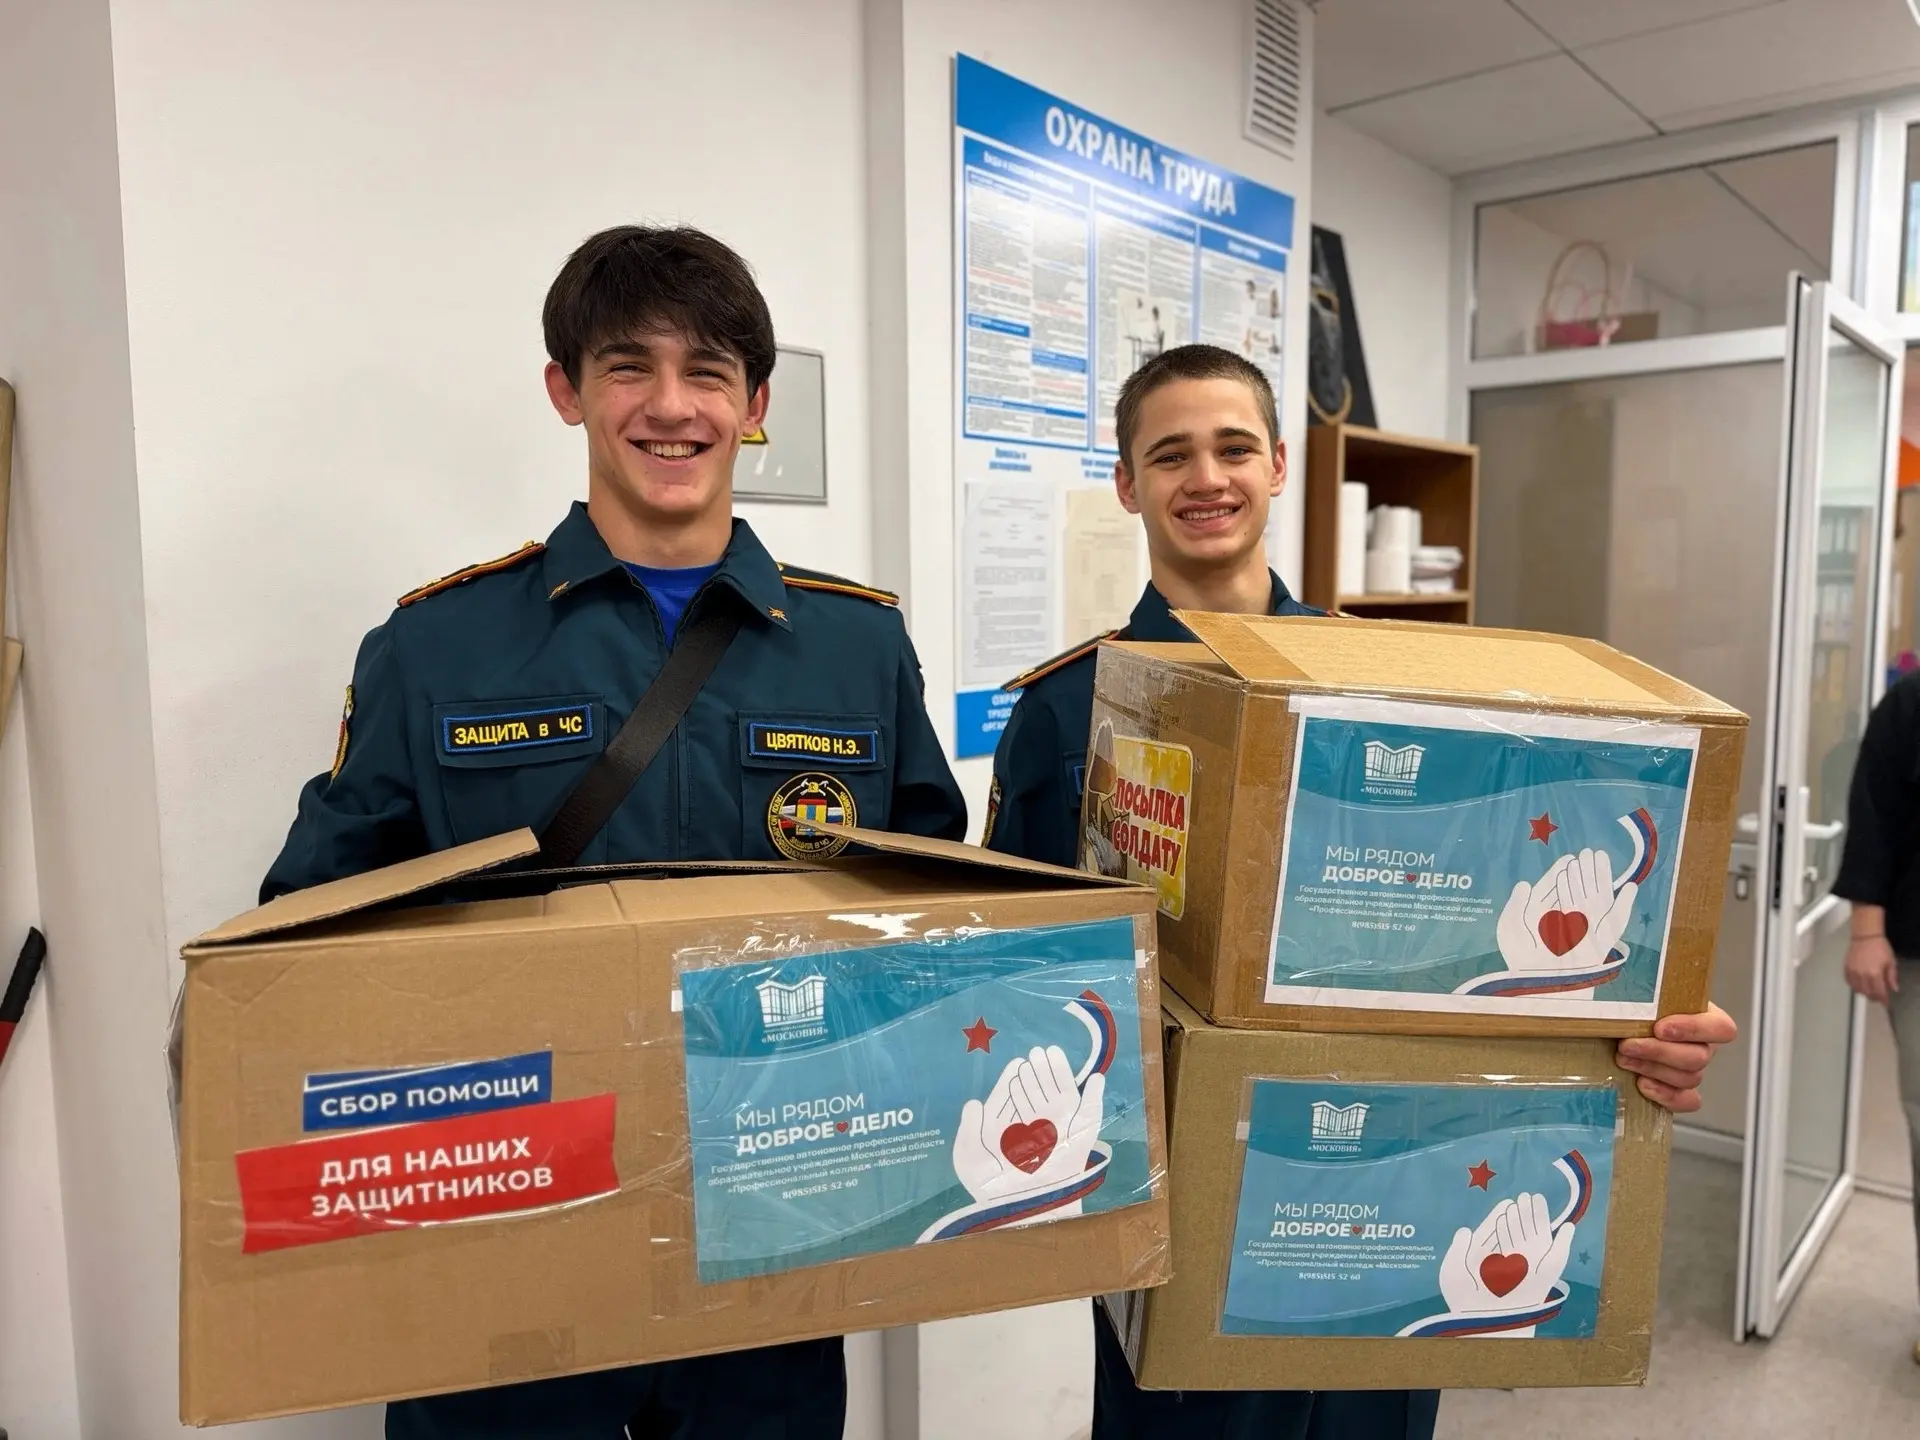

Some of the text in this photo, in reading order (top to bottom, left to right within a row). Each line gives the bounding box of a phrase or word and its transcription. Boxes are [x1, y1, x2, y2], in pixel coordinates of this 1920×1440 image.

[1045, 106, 1154, 184] ОХРАНА
[1160, 154, 1237, 216] ТРУДА
[454, 722, 529, 745] ЗАЩИТА
[559, 715, 582, 734] ЧС
[766, 731, 860, 755] ЦВЯТКОВ Н.Э.
[1114, 777, 1185, 831] ПОСЫЛКА
[1113, 819, 1181, 877] СОЛДАТУ
[1326, 845, 1435, 869] МЫ РЯДОМ
[1299, 884, 1368, 898] Государственное
[1322, 865, 1472, 890] ДОБРОЕ ДЕЛО
[320, 1075, 539, 1117] СБОР ПОМОЩИ
[736, 1093, 864, 1131] МЫ РЯДОМ
[711, 1128, 941, 1174] Государственное автономное профессиональное
[736, 1108, 914, 1156] ДОБРОЕ ДЕЛО
[320, 1136, 531, 1187] ДЛЯ НАШИХ
[707, 1138, 945, 1187] образовательное учреждение Московской области
[829, 1162, 871, 1177] колледж
[312, 1166, 554, 1217] ЗАЩИТНИКОВ
[1270, 1221, 1415, 1240] ДОБРОЕ ДЕЛО
[1274, 1202, 1379, 1221] МЫ РЯДОМ
[1248, 1240, 1315, 1250] Государственное
